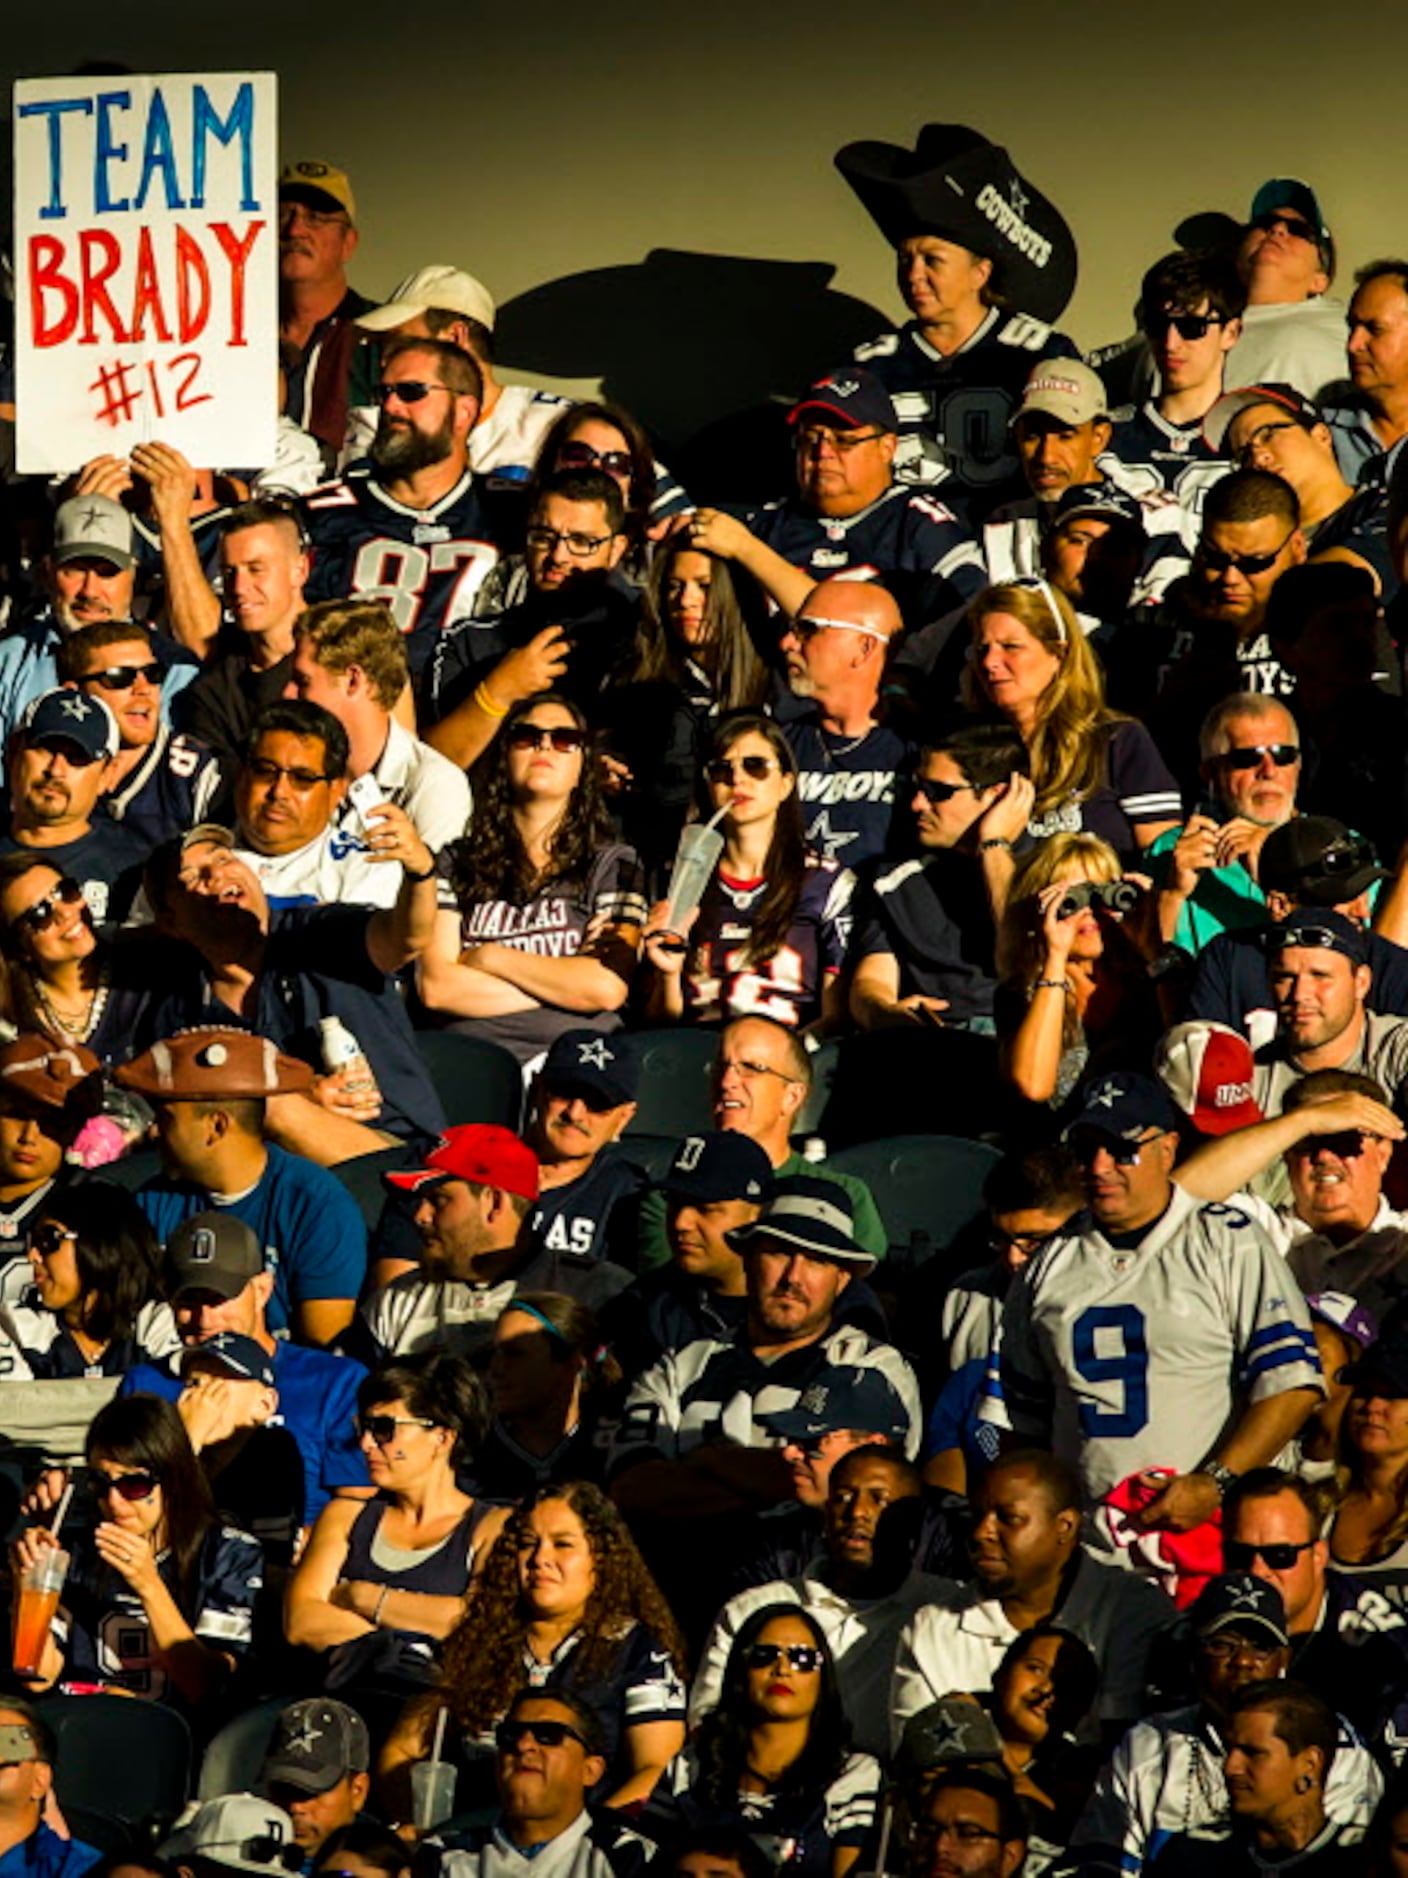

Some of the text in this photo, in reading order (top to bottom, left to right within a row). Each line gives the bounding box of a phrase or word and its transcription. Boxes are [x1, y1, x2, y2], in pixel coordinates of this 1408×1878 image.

[20, 83, 260, 218] TEAM
[975, 184, 1053, 269] COWBOYS
[28, 221, 267, 348] BRADY
[89, 352, 215, 427] #12
[349, 536, 500, 634] 87
[675, 1136, 706, 1172] D
[190, 1226, 217, 1265] D
[532, 1211, 596, 1257] AS
[1073, 1304, 1151, 1438] 9
